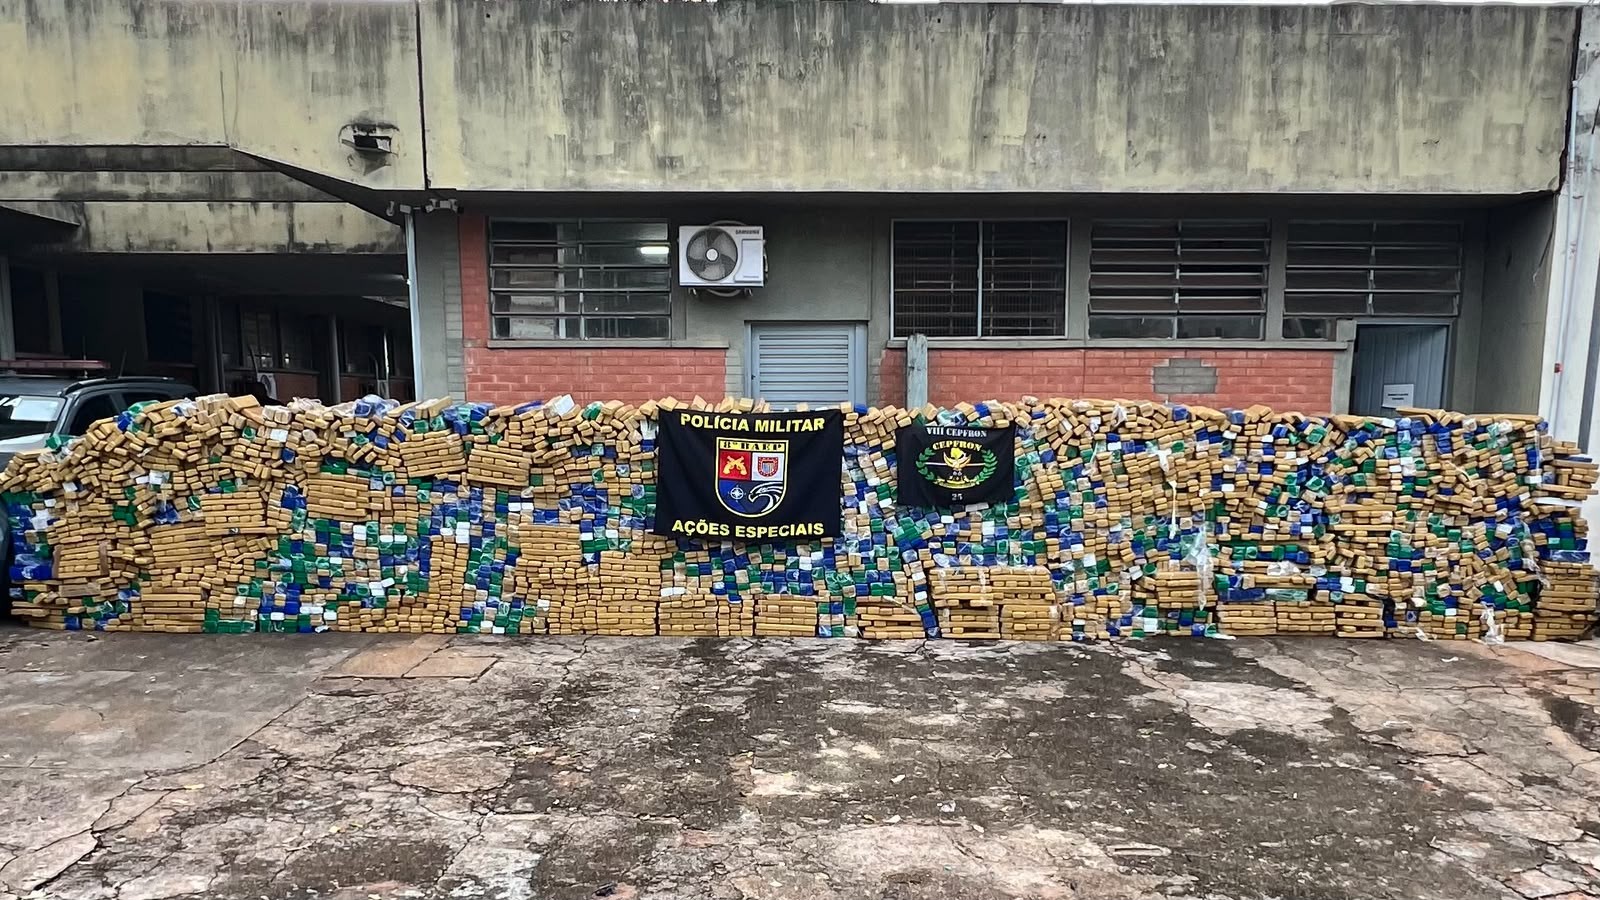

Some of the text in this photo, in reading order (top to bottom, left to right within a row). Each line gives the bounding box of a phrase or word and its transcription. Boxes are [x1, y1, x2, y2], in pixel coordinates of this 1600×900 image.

[680, 413, 825, 433] POLÍCIA MILITAR
[926, 427, 987, 437] VIII CEPFRON
[740, 442, 782, 451] BAEP
[932, 440, 982, 452] CEPFRON
[672, 519, 824, 539] AÇÕES ESPECIAIS
